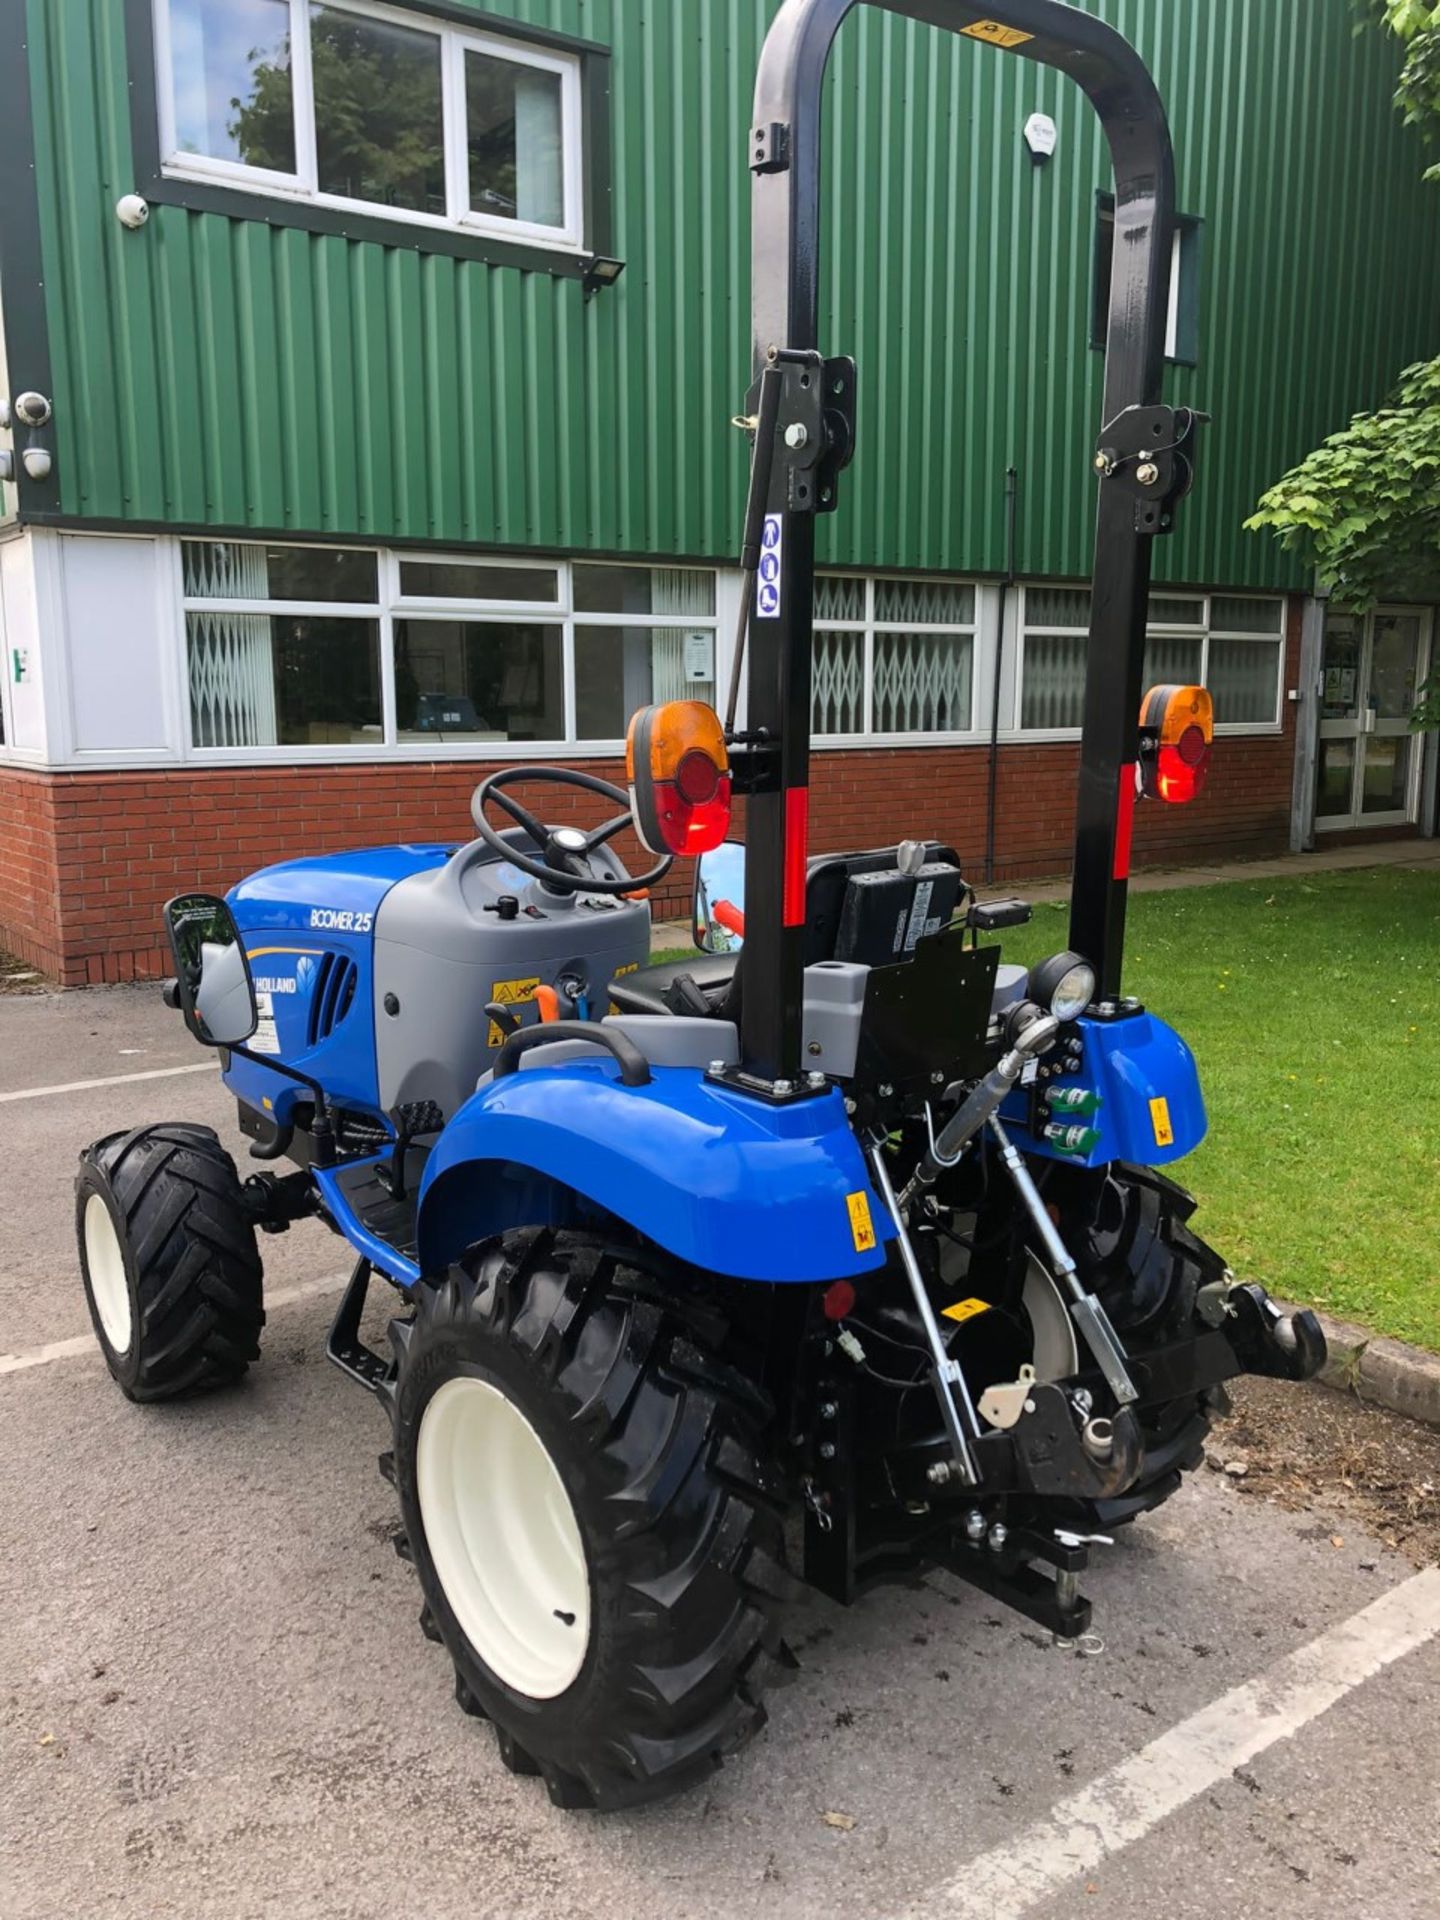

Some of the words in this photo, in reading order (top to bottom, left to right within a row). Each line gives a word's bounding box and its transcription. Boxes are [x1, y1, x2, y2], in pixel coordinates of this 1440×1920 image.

[310, 909, 353, 930] BOOMER
[354, 912, 372, 932] 25
[255, 976, 297, 994] HOLLAND
